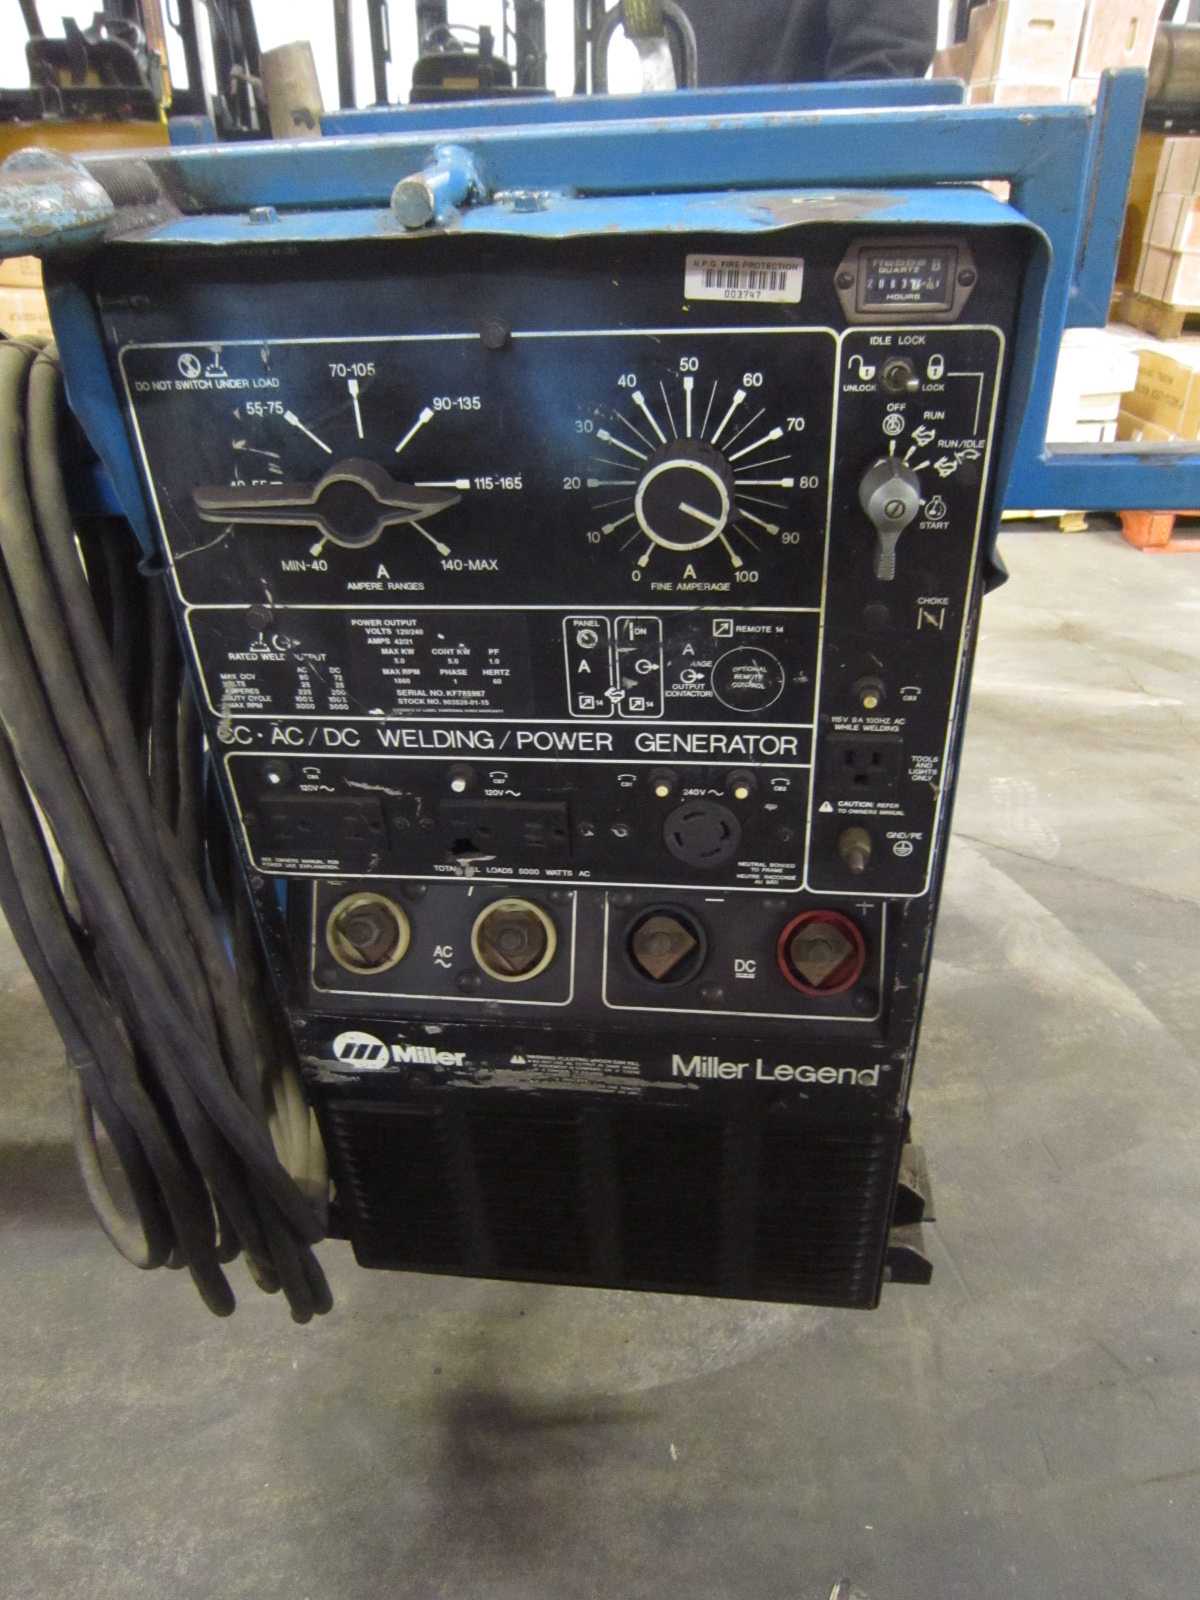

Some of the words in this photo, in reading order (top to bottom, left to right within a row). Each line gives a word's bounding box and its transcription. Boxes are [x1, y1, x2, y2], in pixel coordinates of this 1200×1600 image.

[743, 261, 798, 270] PROTECTION
[878, 266, 920, 274] QUARTZ
[724, 290, 761, 298] 003747
[870, 336, 891, 345] IDLE
[898, 336, 925, 345] LOCK
[329, 363, 375, 377] 70-105
[679, 357, 699, 372] 50
[135, 381, 150, 391] DO
[152, 381, 172, 391] NOT
[175, 380, 212, 390] SWITCH
[215, 379, 250, 389] UNDER
[252, 378, 280, 388] LOAD
[618, 374, 637, 388] 40
[743, 373, 763, 387] 60
[843, 384, 877, 392] UNLOCK
[922, 384, 945, 392] LOCK
[246, 401, 284, 415] 55-75
[433, 397, 481, 410] 90-135
[886, 403, 906, 412] OFF
[924, 411, 945, 420] RUN
[575, 420, 593, 433] 30
[787, 418, 805, 431] 70
[937, 439, 985, 449] RUN/IDLE
[474, 477, 523, 490] 115-165
[563, 477, 581, 489] 20
[799, 476, 818, 489] 80
[919, 522, 949, 530] START
[586, 532, 600, 544] 10
[781, 532, 799, 544] 90
[281, 560, 328, 572] MIN-40
[441, 559, 499, 571] 140-MAX
[377, 564, 390, 579] A
[631, 570, 641, 582] 0
[683, 564, 697, 579] A
[734, 570, 759, 583] 100
[347, 582, 384, 591] AMPERE
[388, 582, 425, 591] RANGES
[651, 582, 673, 591] FINE
[676, 582, 730, 591] AMPERAGE
[917, 597, 949, 606] CHOKE
[735, 625, 772, 633] REMOTE
[682, 643, 695, 656] A
[228, 652, 259, 661] RATED
[297, 666, 308, 674] AC
[577, 659, 591, 673] A
[733, 673, 764, 681] REMOTE
[396, 689, 428, 697] SERIAL
[635, 733, 798, 755] GENERATOR
[683, 788, 706, 796] 240V
[837, 800, 874, 808] CAUTION:
[886, 831, 923, 840] GND/PE
[486, 866, 513, 874] LOADS
[433, 945, 453, 958] AC
[734, 959, 757, 972] DC
[391, 1044, 467, 1067] Miller
[672, 1054, 749, 1080] Miller
[756, 1058, 880, 1086] Legend
